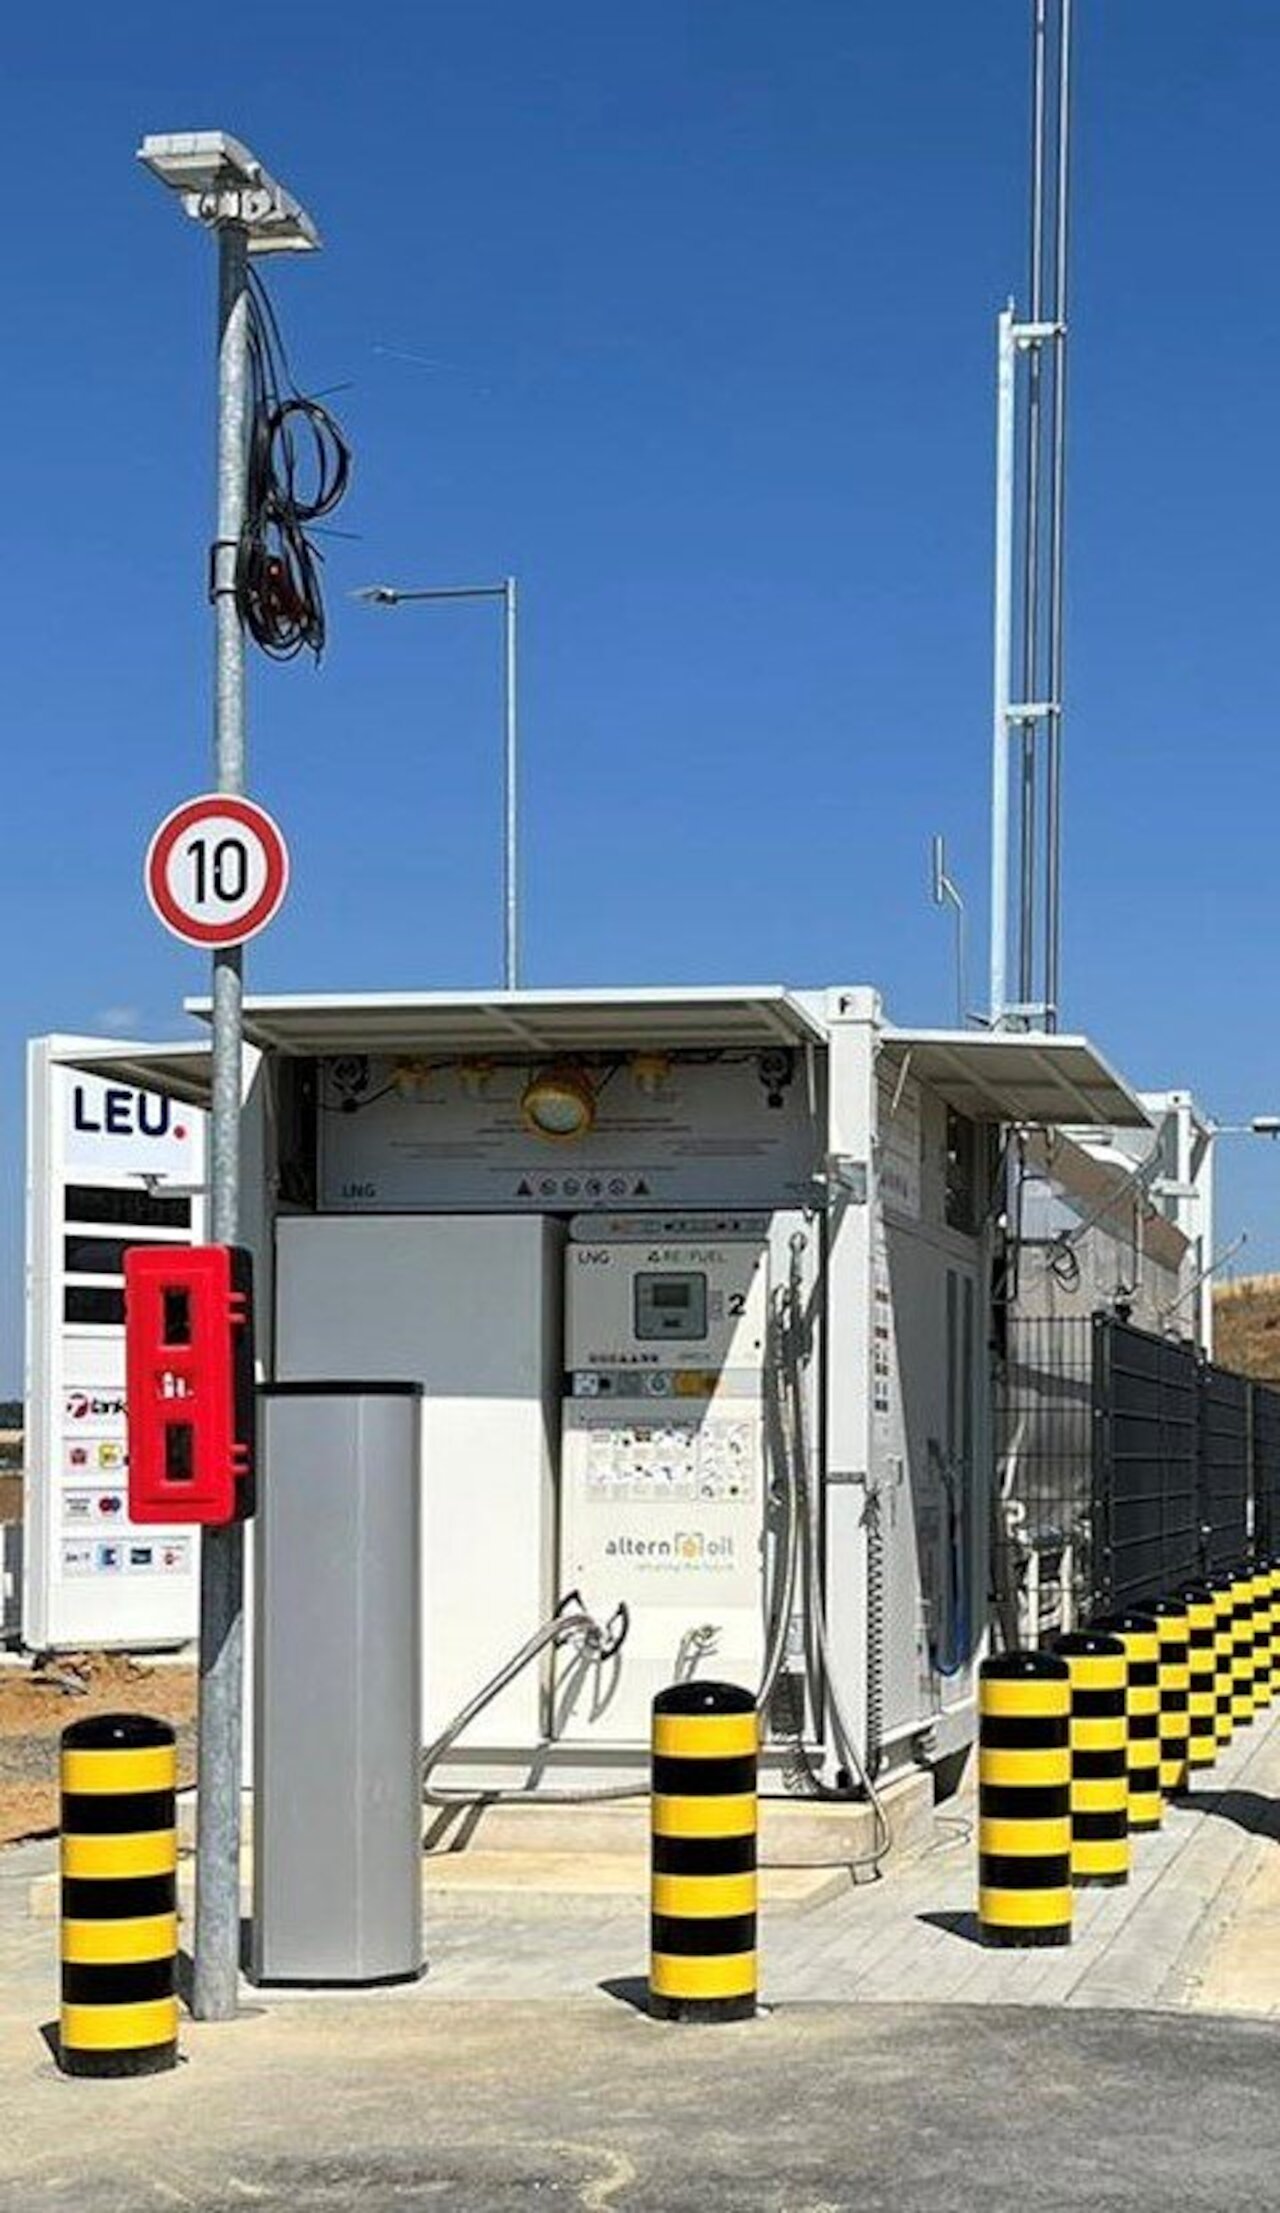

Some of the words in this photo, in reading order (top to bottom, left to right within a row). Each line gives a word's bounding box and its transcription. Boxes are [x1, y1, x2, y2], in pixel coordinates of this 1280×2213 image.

[186, 838, 248, 904] 10
[343, 1182, 376, 1198] LNG
[578, 1250, 611, 1265] LNG
[727, 1292, 747, 1318] 2
